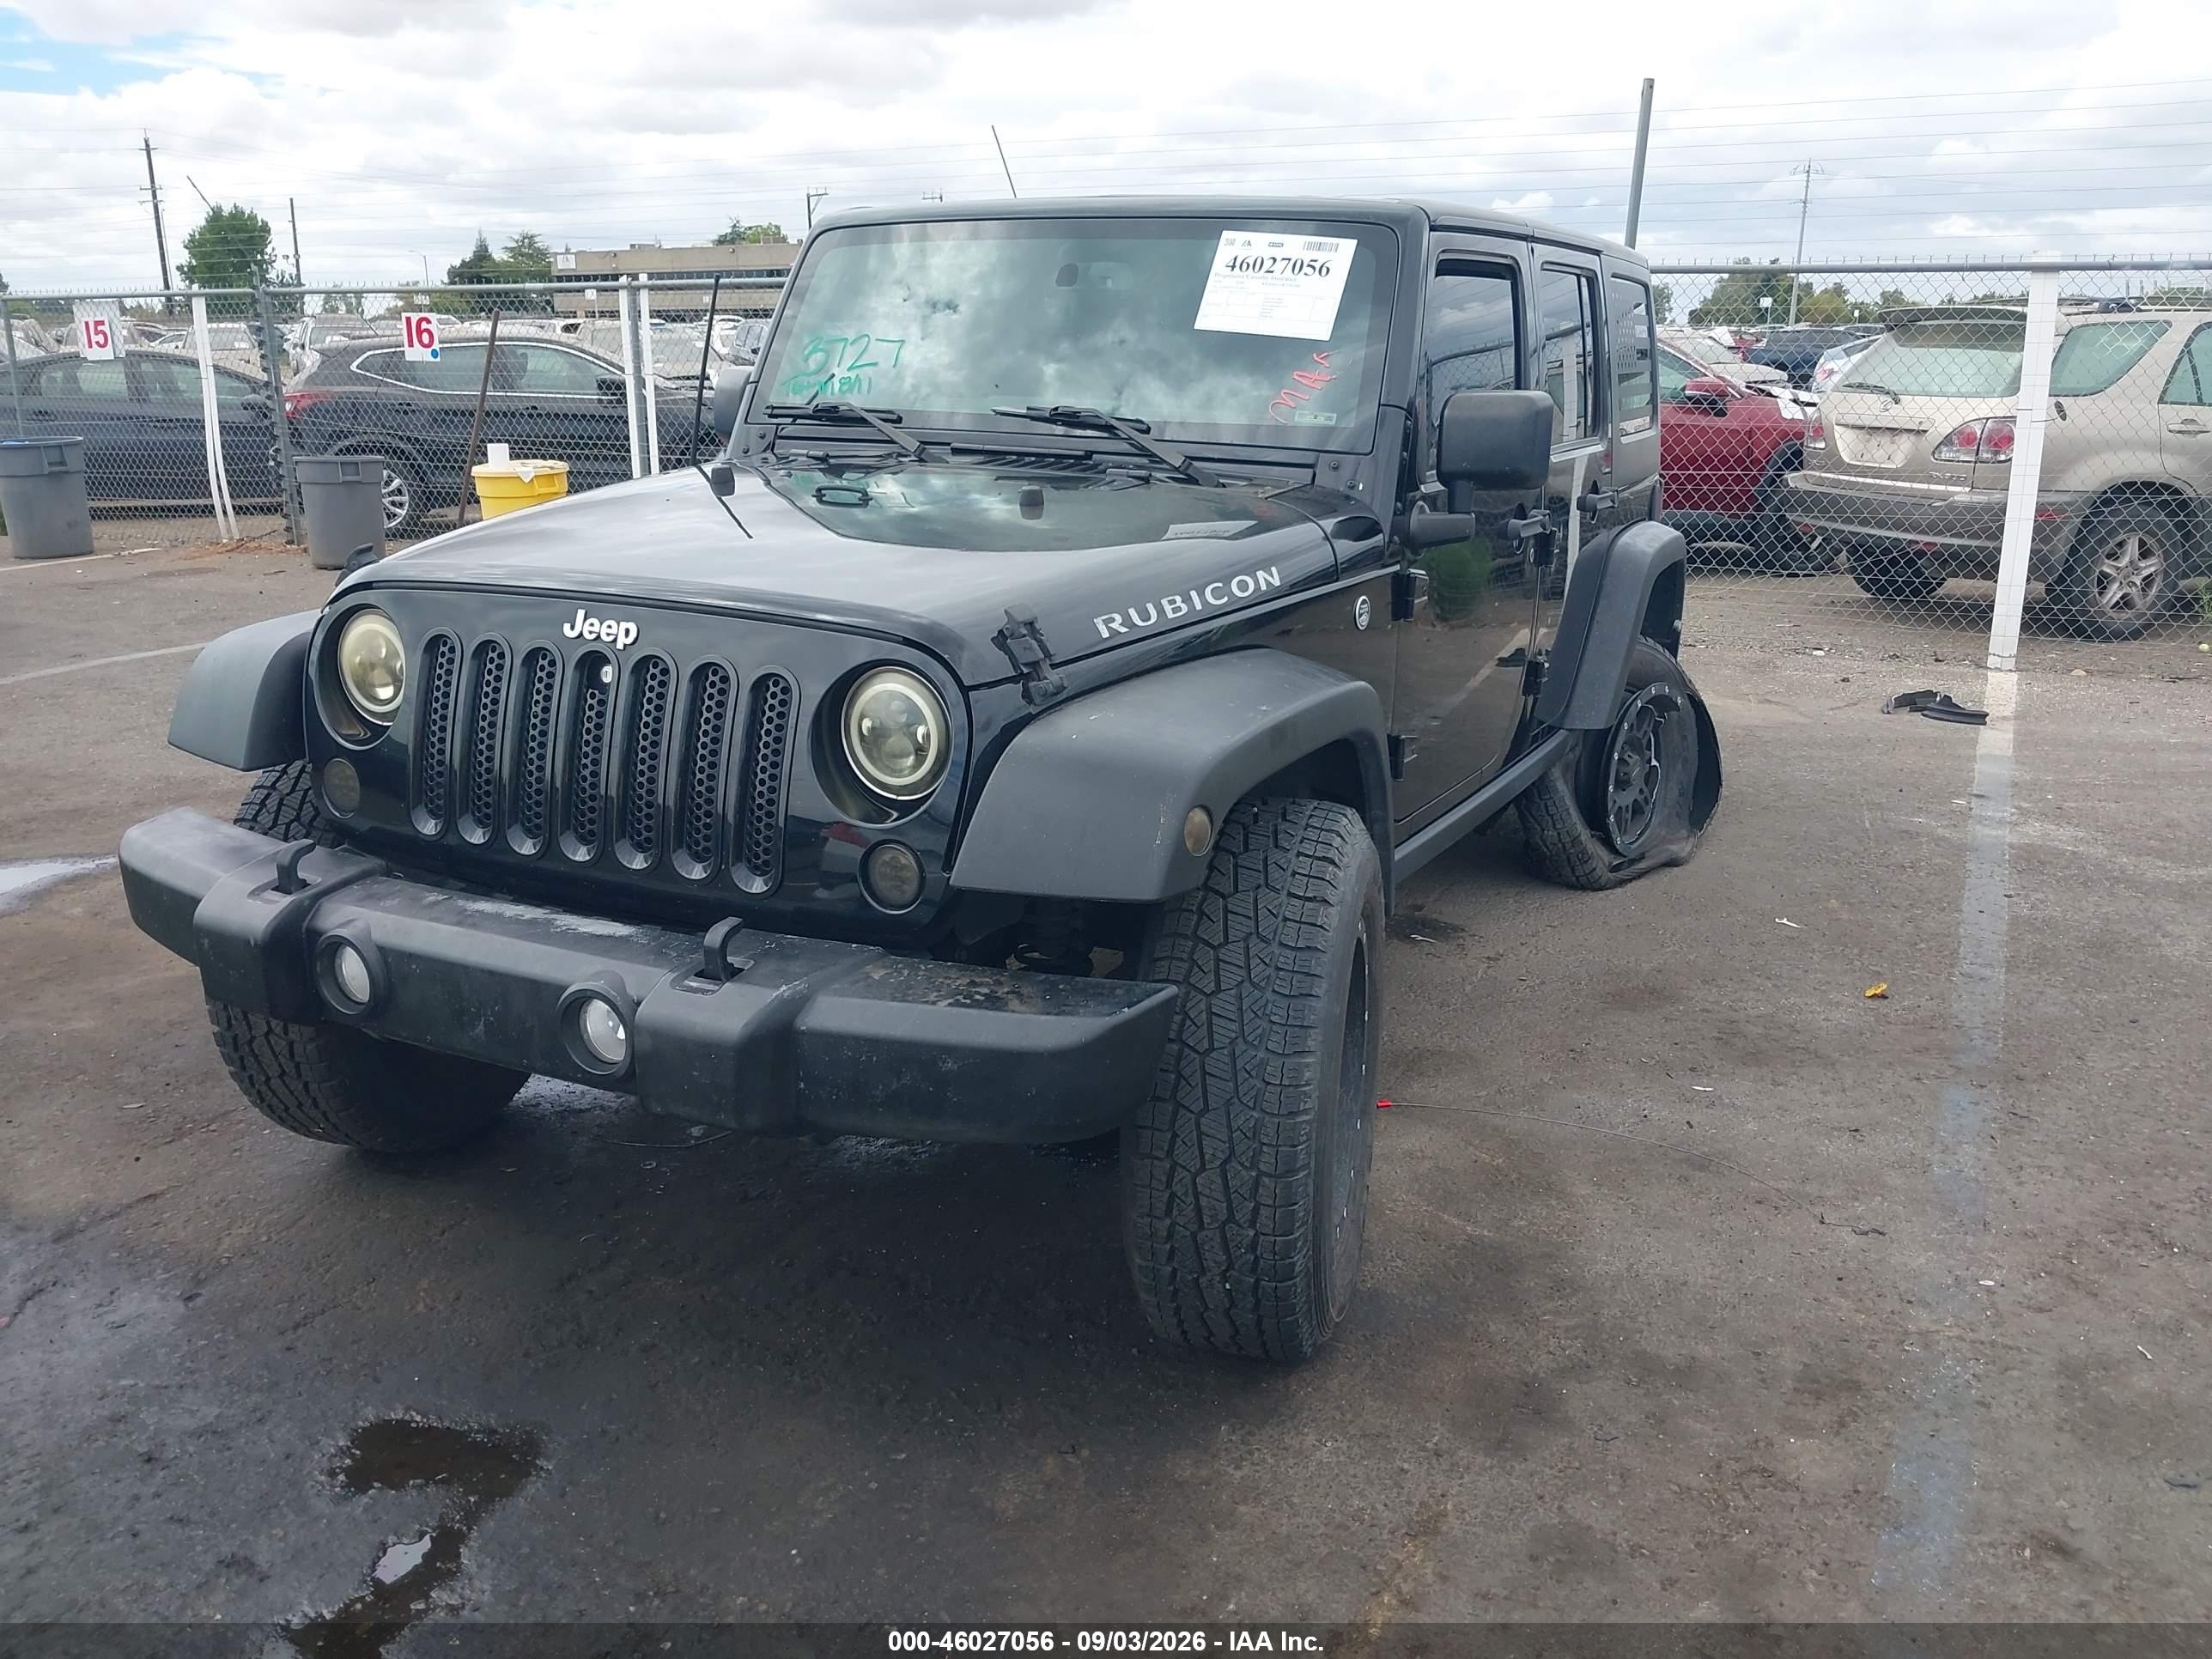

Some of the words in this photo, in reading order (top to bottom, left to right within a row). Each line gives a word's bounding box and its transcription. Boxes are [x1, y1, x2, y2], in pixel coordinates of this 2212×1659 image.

[1225, 255, 1333, 277] 46027056
[84, 319, 108, 349] 15
[405, 316, 434, 349] 16
[1093, 567, 1281, 639] RUBICON
[563, 609, 638, 650] Jeep
